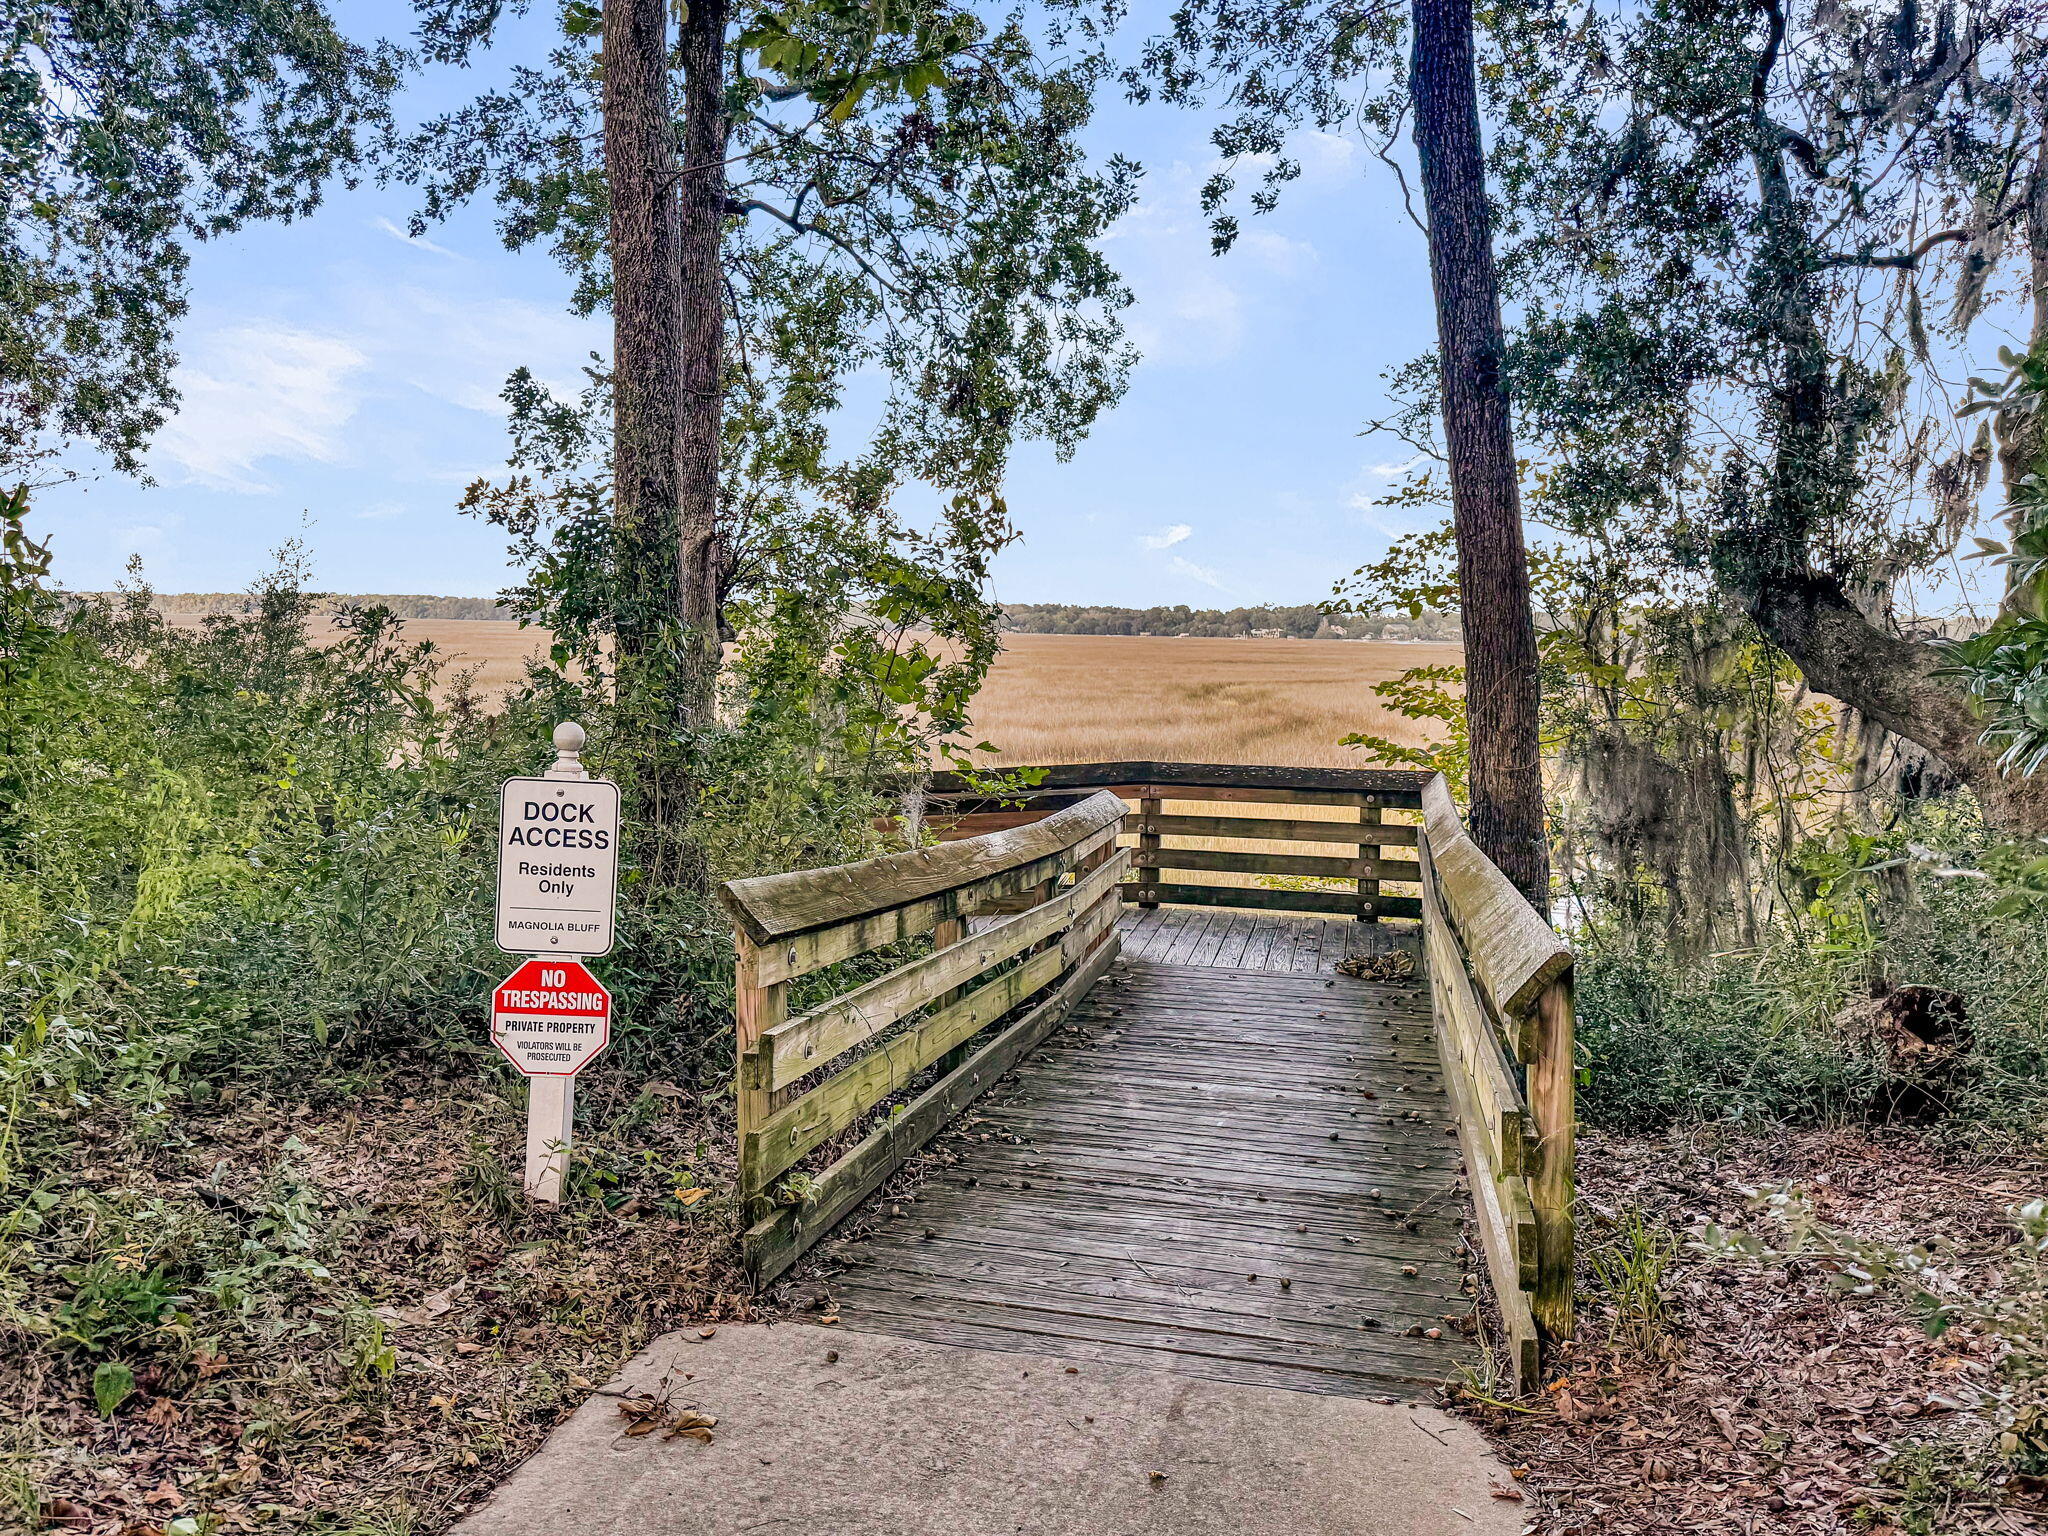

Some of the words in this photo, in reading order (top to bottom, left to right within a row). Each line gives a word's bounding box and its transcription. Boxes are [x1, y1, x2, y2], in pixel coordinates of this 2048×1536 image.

[524, 801, 595, 824] DOCK
[508, 826, 609, 850] ACCESS
[518, 861, 596, 878] Residents
[538, 879, 574, 897] Only
[508, 920, 565, 931] MAGNOLIA
[567, 923, 601, 933] BLUFF
[541, 969, 566, 988] NO
[501, 989, 603, 1011] TRESPASSING
[505, 1020, 544, 1033] PRIVATE
[546, 1022, 596, 1034] PROPERTY
[516, 1040, 554, 1051] VIOLATORS
[554, 1042, 572, 1051] WILL
[573, 1043, 582, 1052] BE
[526, 1052, 571, 1062] PROSECUTED
